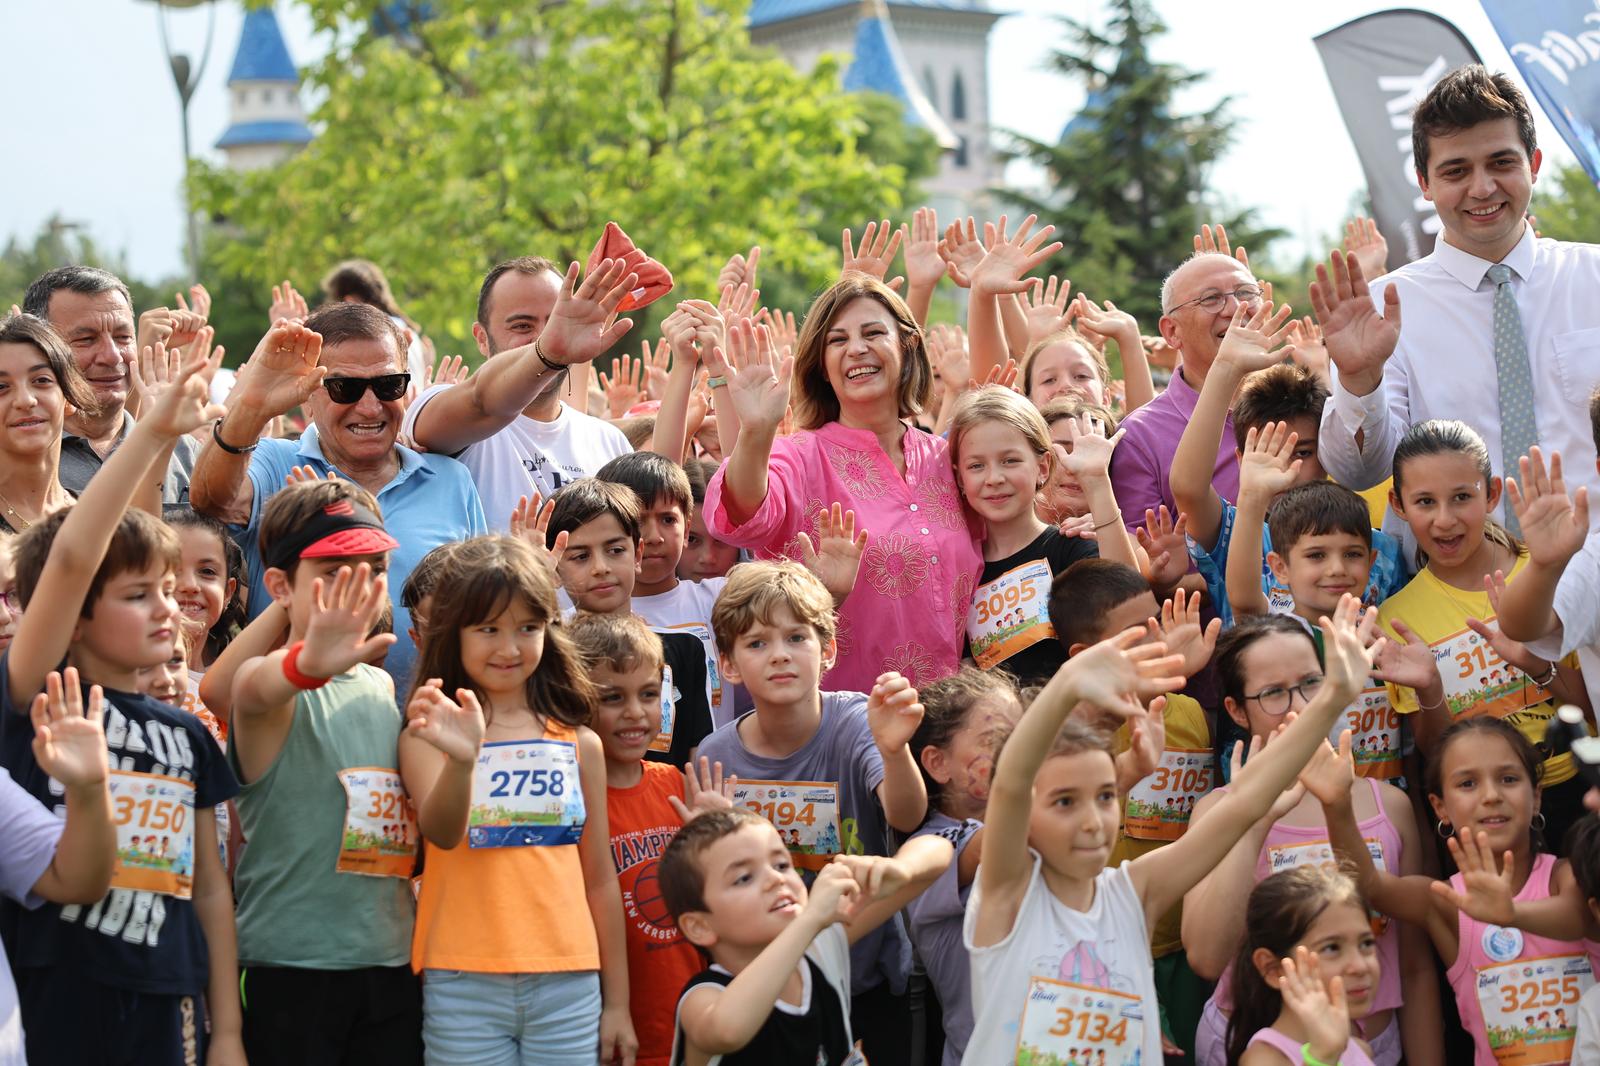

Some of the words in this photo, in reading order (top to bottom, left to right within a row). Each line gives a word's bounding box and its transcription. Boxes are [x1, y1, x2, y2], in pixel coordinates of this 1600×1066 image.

[975, 578, 1037, 624] 3095
[1455, 643, 1504, 678] 313
[1347, 707, 1399, 735] 3016
[490, 770, 564, 797] 2758
[1151, 767, 1209, 792] 3105
[115, 796, 185, 833] 3150
[623, 891, 639, 918] NEW
[637, 921, 677, 939] JERSEY
[1500, 976, 1580, 1013] 3255
[1048, 1007, 1128, 1046] 3134
